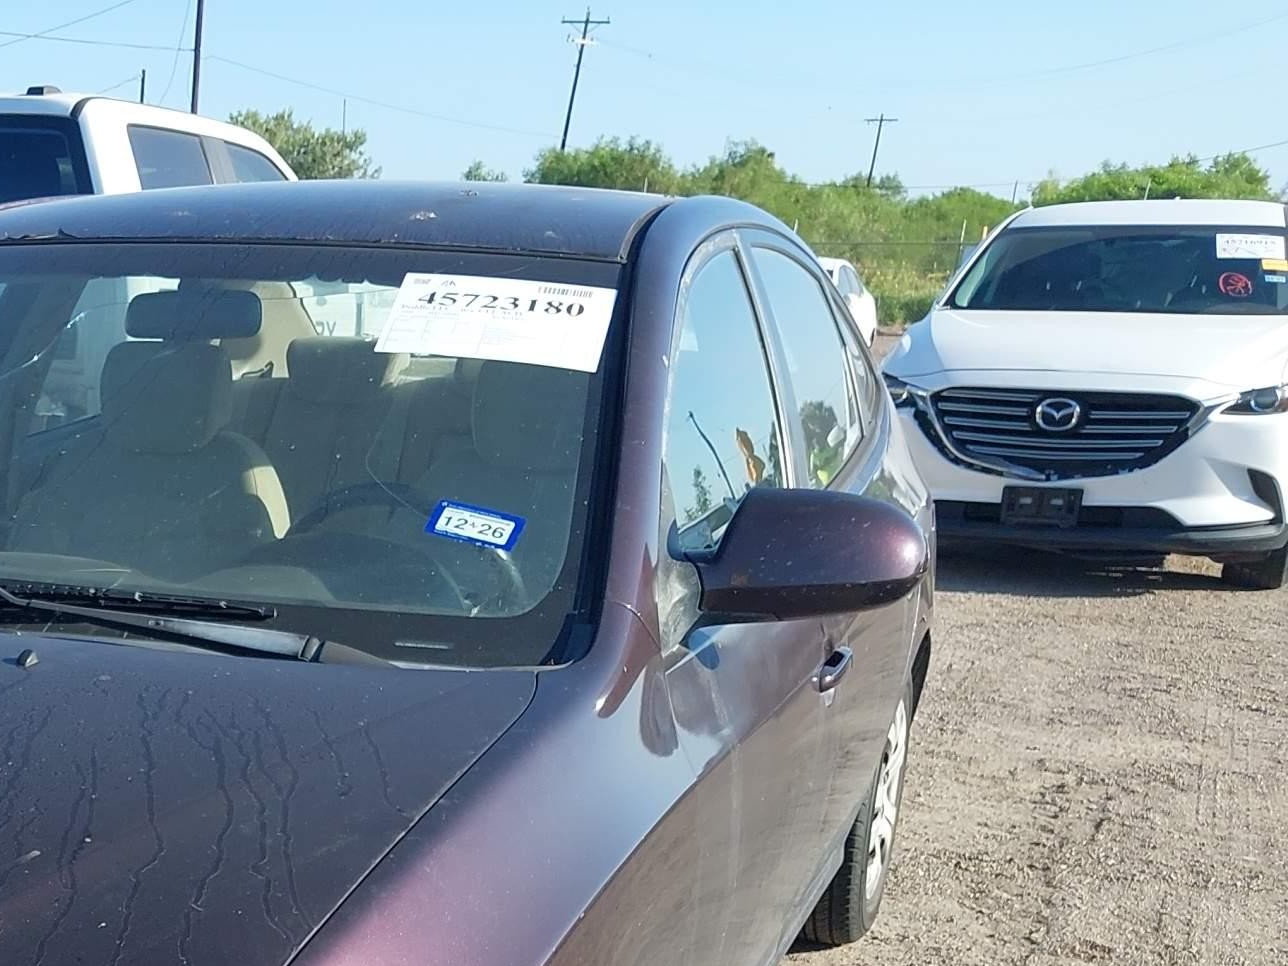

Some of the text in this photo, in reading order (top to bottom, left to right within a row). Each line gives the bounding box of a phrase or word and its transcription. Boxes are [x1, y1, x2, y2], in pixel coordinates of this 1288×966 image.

[417, 290, 586, 318] 45723180
[444, 515, 469, 530] 12
[477, 522, 507, 539] 26
